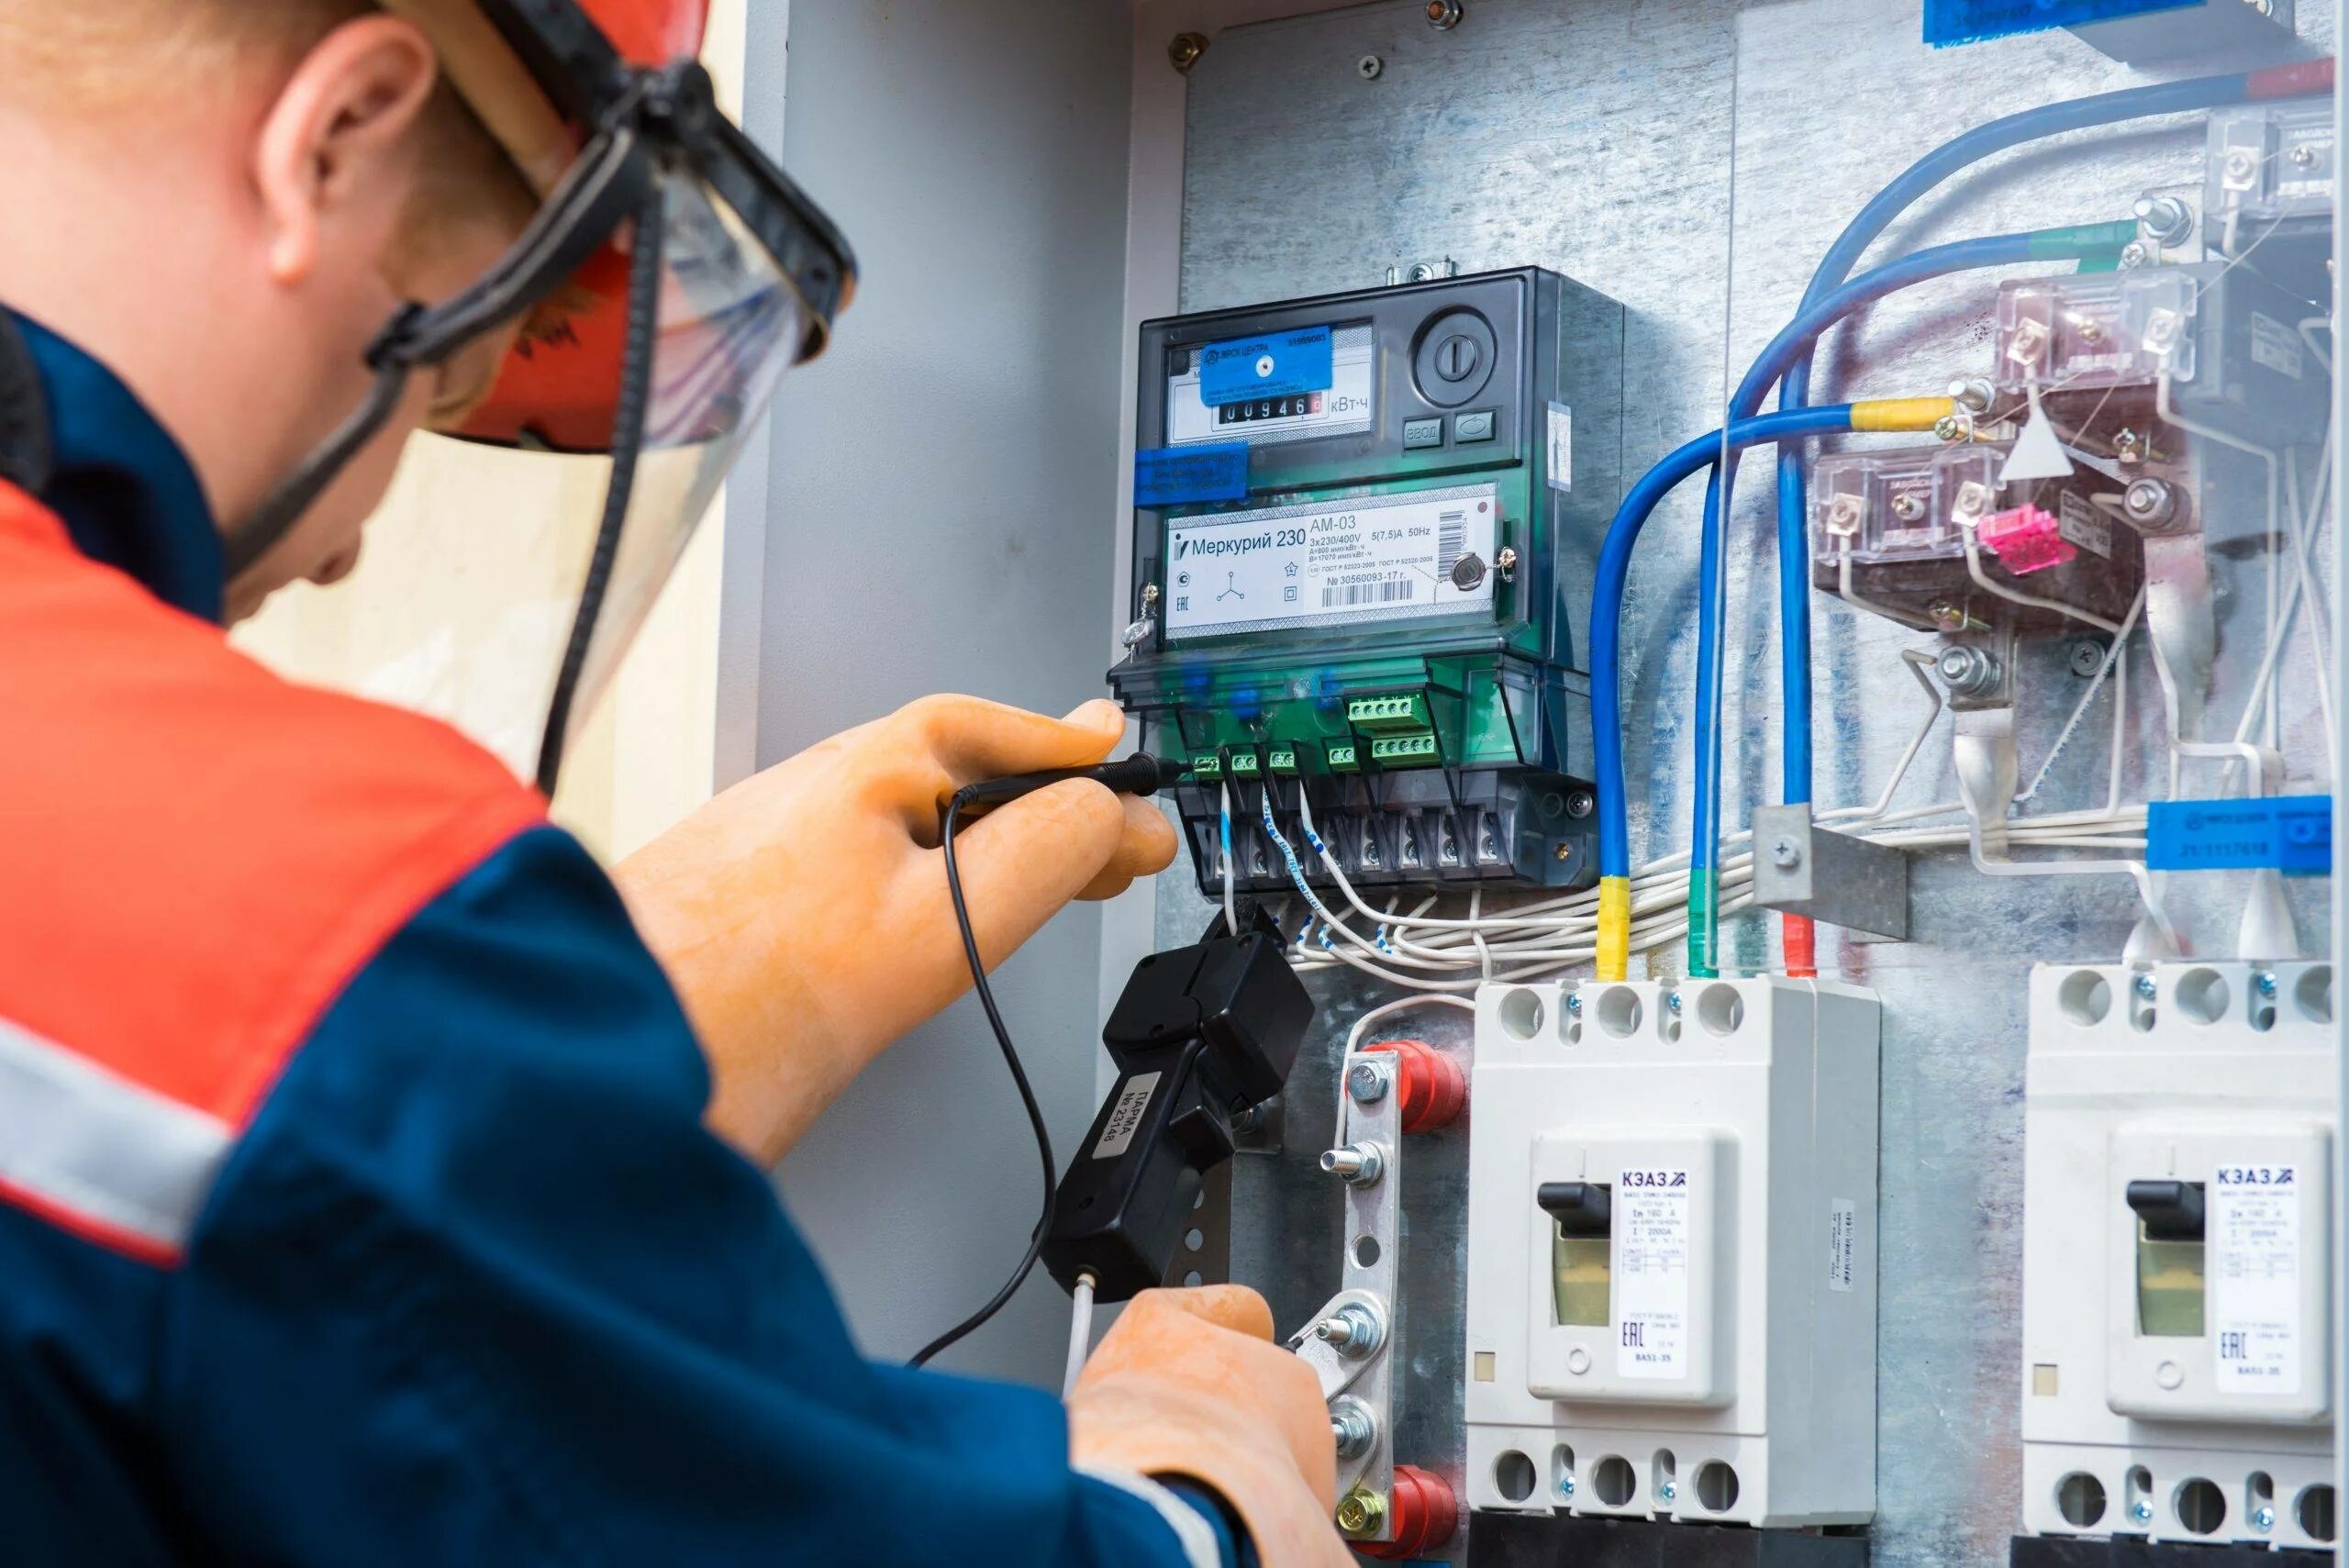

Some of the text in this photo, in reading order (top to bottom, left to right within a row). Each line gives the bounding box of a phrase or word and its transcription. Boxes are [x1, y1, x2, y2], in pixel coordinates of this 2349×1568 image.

[1242, 343, 1269, 357] ЦЕНТРА
[1406, 426, 1437, 440] ВВОД
[1309, 515, 1356, 533] АМ-03
[1408, 528, 1431, 538] 50Hz
[1192, 528, 1306, 557] Меркурий 230
[1321, 565, 1337, 573] ГОСТ
[1327, 576, 1339, 586] №
[1341, 571, 1397, 585] 30560093-17
[1103, 1092, 1136, 1142] № 23148
[1119, 1091, 1149, 1136] ПАРМА
[1622, 1172, 1667, 1186] КЭАЗ
[2218, 1168, 2270, 1184] КЭАЗ
[1622, 1321, 1644, 1347] EAC
